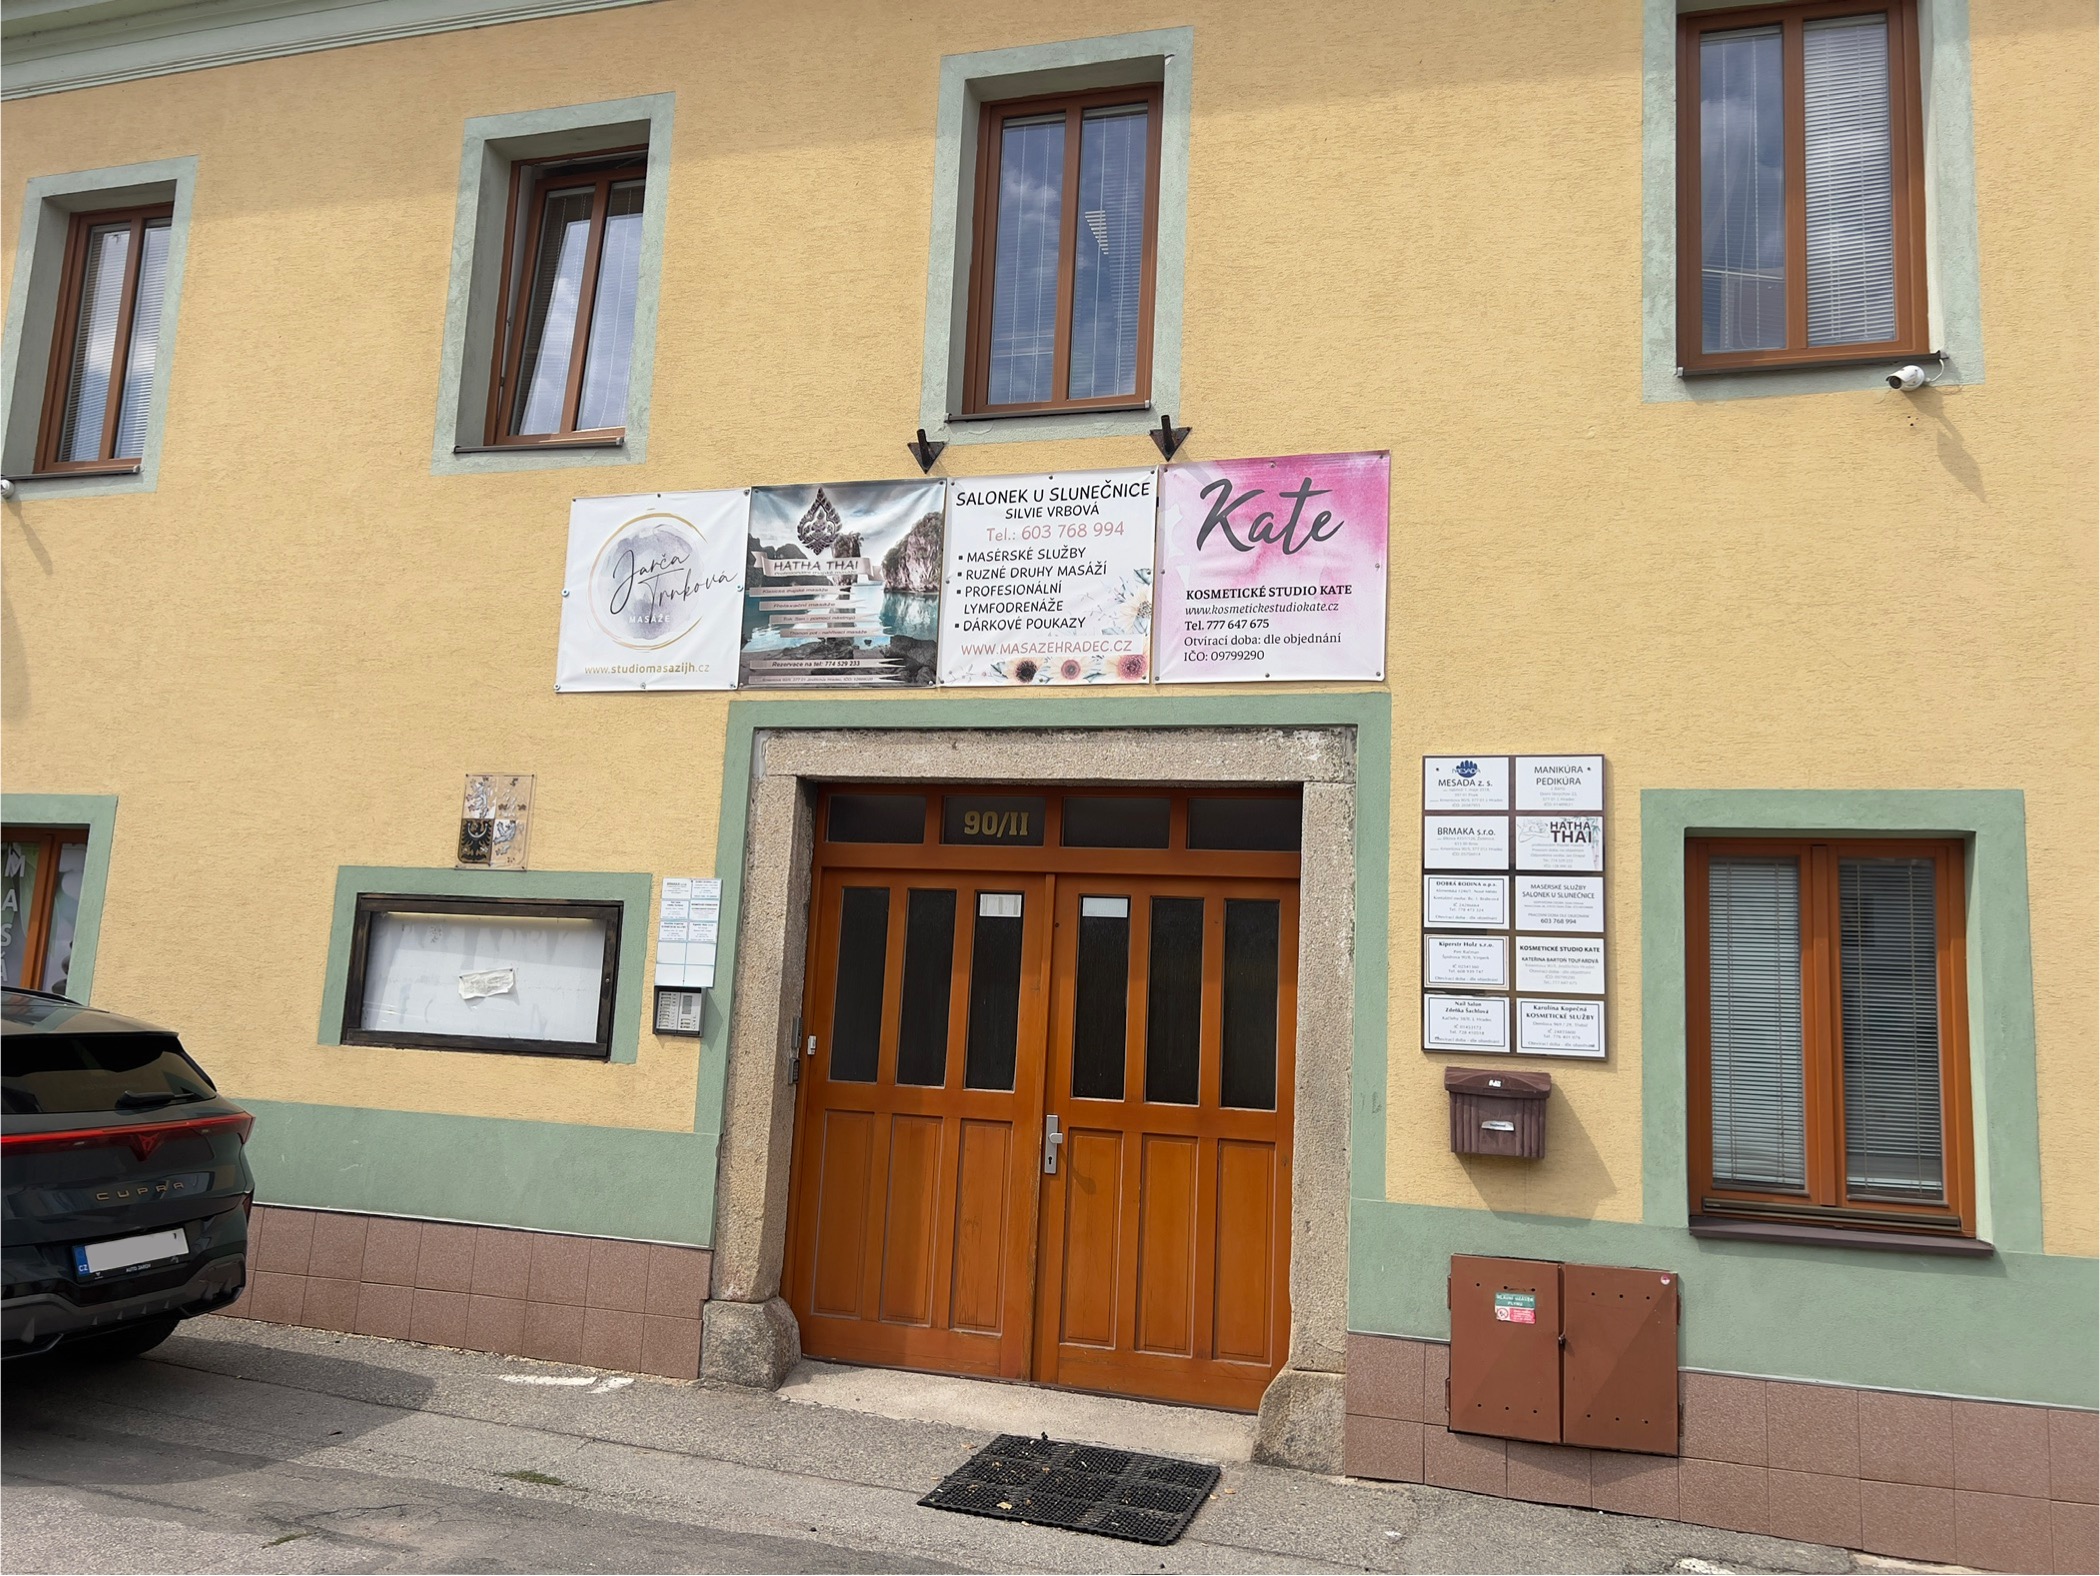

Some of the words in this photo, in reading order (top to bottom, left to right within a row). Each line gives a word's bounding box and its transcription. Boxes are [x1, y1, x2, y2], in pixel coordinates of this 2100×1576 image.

[956, 489, 1028, 506] SALONEK
[1034, 489, 1044, 502] U
[1049, 479, 1151, 502] SLUNEČNICE
[1005, 506, 1043, 520] SILVIE
[1047, 502, 1100, 517] VRBOVÁ
[1196, 476, 1345, 555] Kate
[987, 527, 1016, 541] Tel.:
[1021, 525, 1052, 540] 603
[1058, 523, 1088, 538] 768
[1093, 520, 1125, 536] 994
[967, 547, 1033, 562] MASÉRSKÉ
[1037, 545, 1087, 560] SLUŽBY
[774, 560, 821, 571] HATHA
[827, 560, 858, 570] THAI
[966, 566, 1006, 580] RUZNÉ
[1010, 566, 1054, 579] DRUHY
[1057, 560, 1108, 576] MASÁŽÍ
[610, 549, 690, 614] Jarča
[965, 580, 1062, 598] PROFESIONÁLNÍ
[638, 568, 738, 624] Trnková
[1186, 585, 1266, 600] KOSMETICKÉ
[1268, 586, 1317, 597] STUDIO
[1320, 584, 1352, 596] KATE
[964, 598, 1064, 614] LYMFODRENÁŽE
[1184, 602, 1339, 616] www.kosmetickestudiokate.cz
[963, 617, 1022, 632] DÁRKOVÉ
[1026, 616, 1086, 630] POUKAZY
[1184, 620, 1204, 631] Tel.
[1206, 620, 1226, 630] 777
[1227, 620, 1248, 630] 647
[1250, 618, 1270, 628] 675
[1184, 635, 1228, 647] Otvírací
[1230, 634, 1261, 646] doba:
[1264, 634, 1281, 645] dle
[1283, 632, 1342, 646] objednání
[961, 640, 1133, 655] WWW.MASAZEHRADEC.CZ
[1184, 650, 1208, 662] IČO:
[1210, 650, 1265, 662] 09799290
[584, 662, 710, 675] www.studiomasazijh.cz
[1534, 765, 1584, 774] MANIKÚRA
[1438, 779, 1476, 787] MESADA
[1536, 776, 1582, 786] PEDIKÚRA
[964, 810, 1030, 838] 90/II
[1437, 826, 1475, 836] BRMAKA
[1477, 828, 1496, 836] s.r.o.
[1550, 821, 1591, 830] HATHA
[1550, 830, 1592, 843] THAI
[1557, 891, 1595, 899] SLUNEČNICE
[96, 1180, 184, 1200] CUPRA
[78, 1264, 88, 1272] CZ
